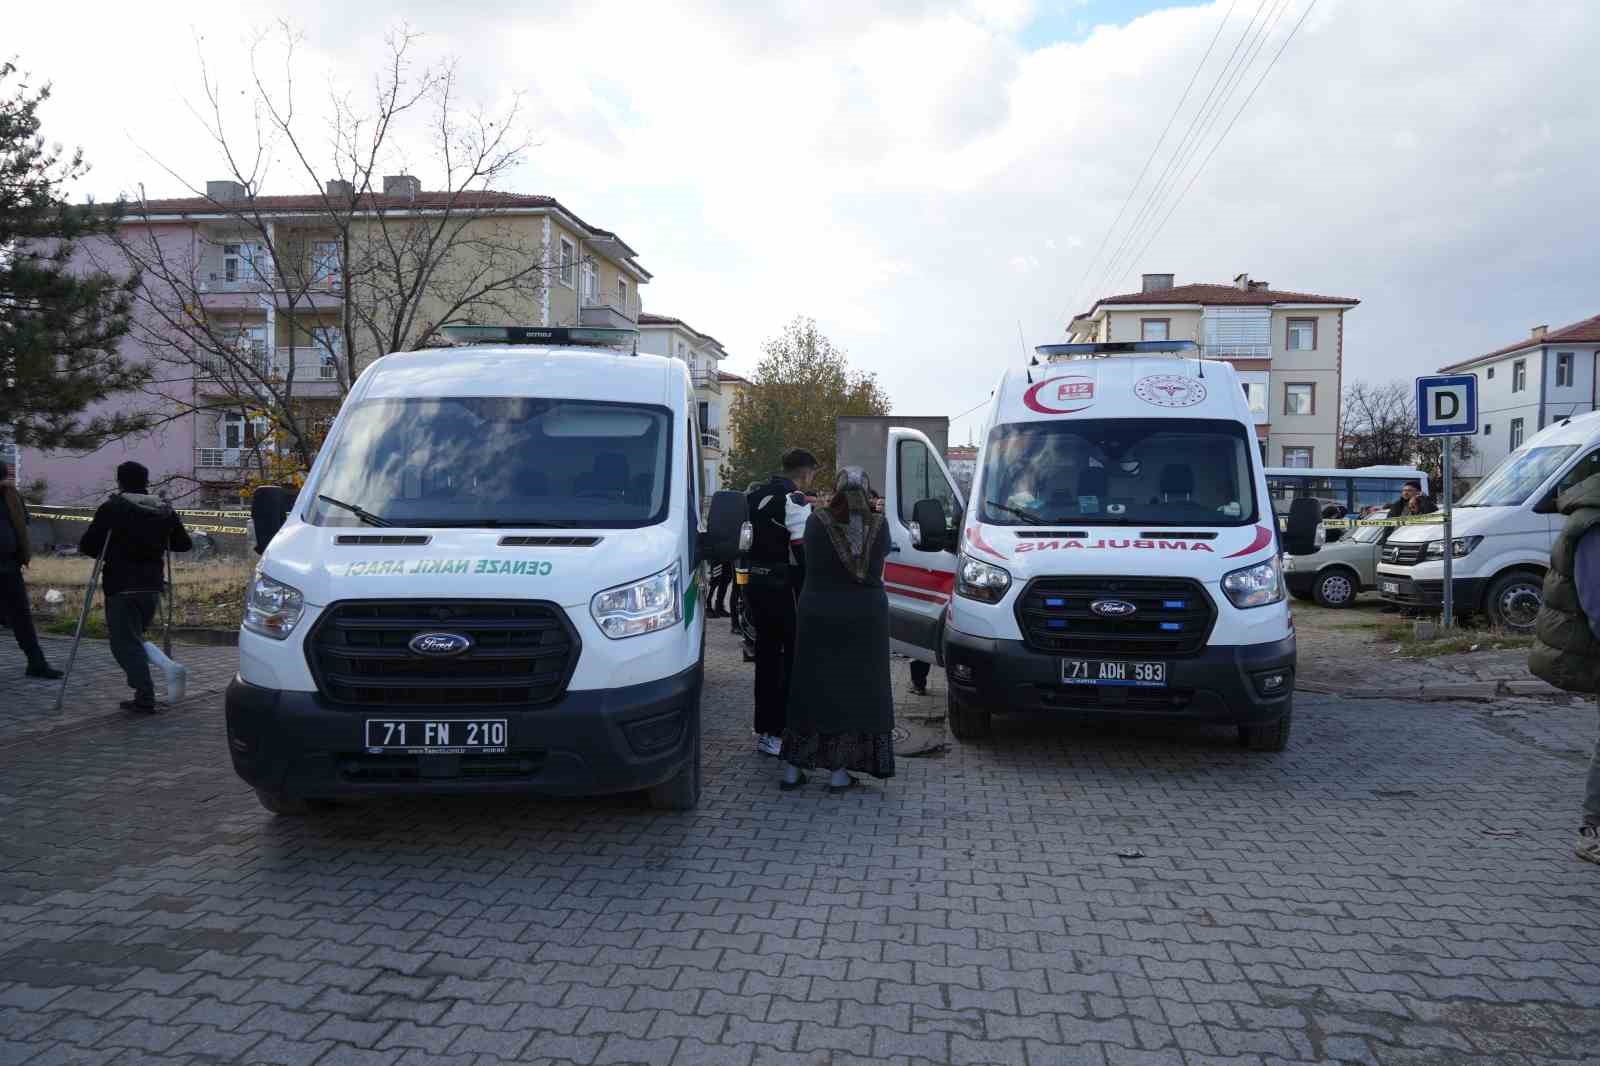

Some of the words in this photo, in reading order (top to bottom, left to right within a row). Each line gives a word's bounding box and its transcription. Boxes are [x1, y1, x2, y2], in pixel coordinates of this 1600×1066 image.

[1065, 384, 1089, 394] 112
[1435, 391, 1459, 420] D
[1071, 661, 1089, 678] 71
[1098, 662, 1126, 680] ADH
[1135, 664, 1163, 681] 583
[383, 722, 406, 745] 71
[424, 722, 450, 745] FN
[466, 722, 504, 745] 210
